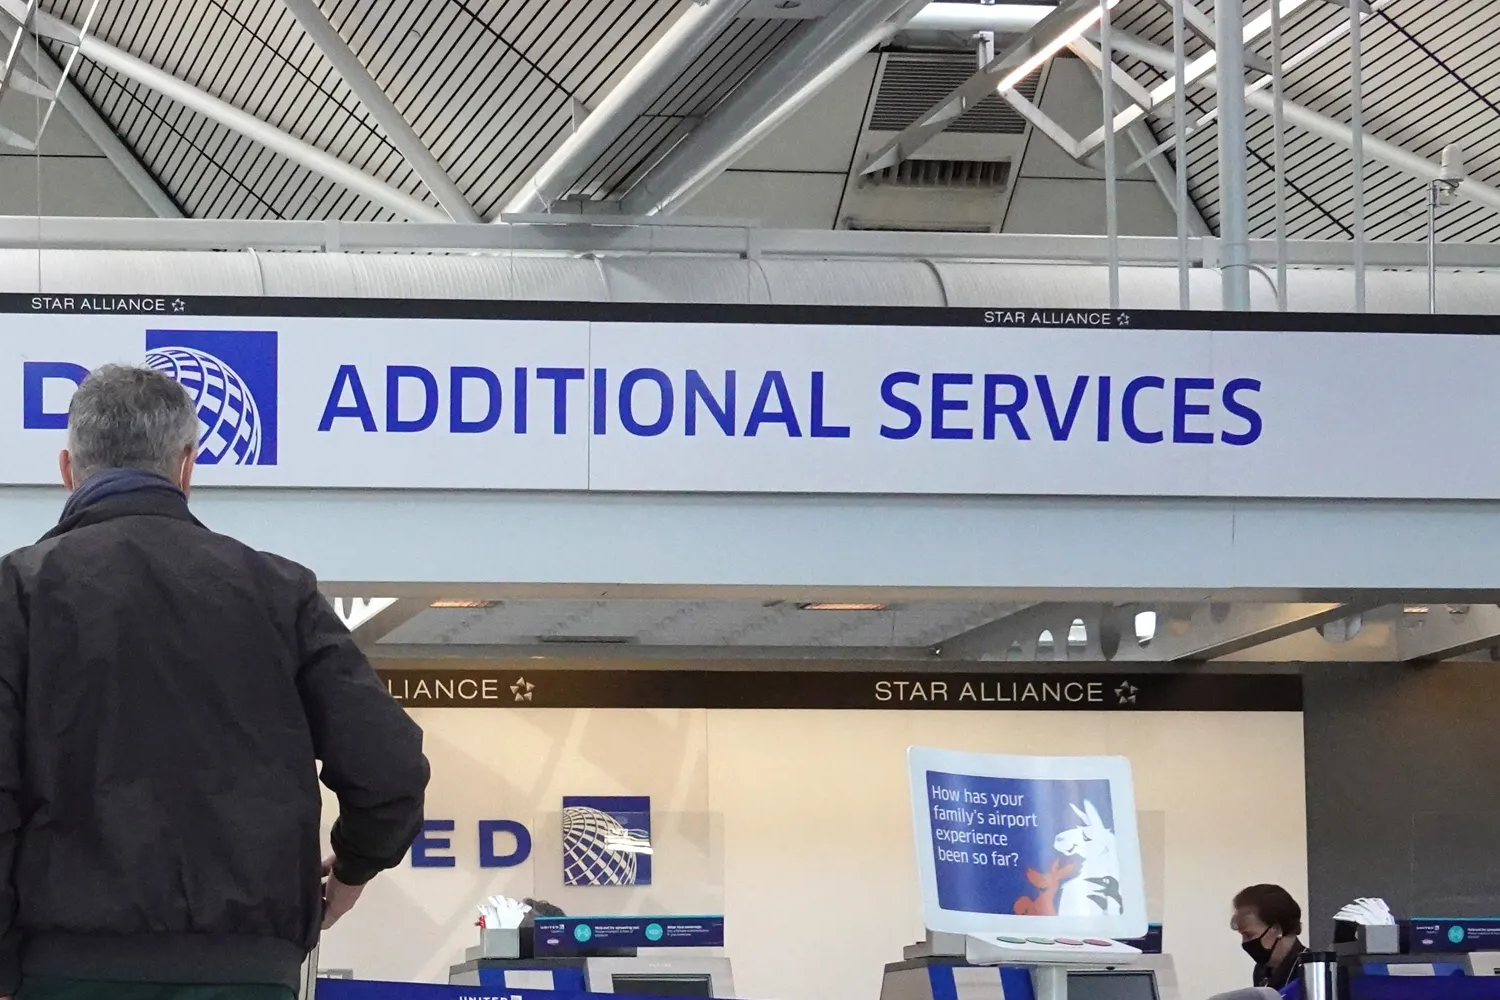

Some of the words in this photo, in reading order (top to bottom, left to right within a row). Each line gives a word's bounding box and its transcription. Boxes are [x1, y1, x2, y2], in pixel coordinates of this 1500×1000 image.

[31, 297, 75, 310] STAR
[80, 297, 165, 311] ALLIANCE
[984, 311, 1025, 324] STAR
[1030, 311, 1111, 325] ALLIANCE
[317, 363, 851, 439] ADDITIONAL
[879, 370, 1264, 446] SERVICES
[388, 679, 499, 700] LIANCE
[874, 680, 948, 702] STAR
[958, 681, 1104, 703] ALLIANCE
[931, 785, 960, 802] How
[964, 788, 988, 804] has
[991, 792, 1024, 808] your
[933, 805, 984, 826] family's
[988, 810, 1038, 829] airport
[936, 828, 1008, 846] experience
[938, 846, 969, 863] been
[972, 852, 988, 865] so
[991, 850, 1019, 867] far?
